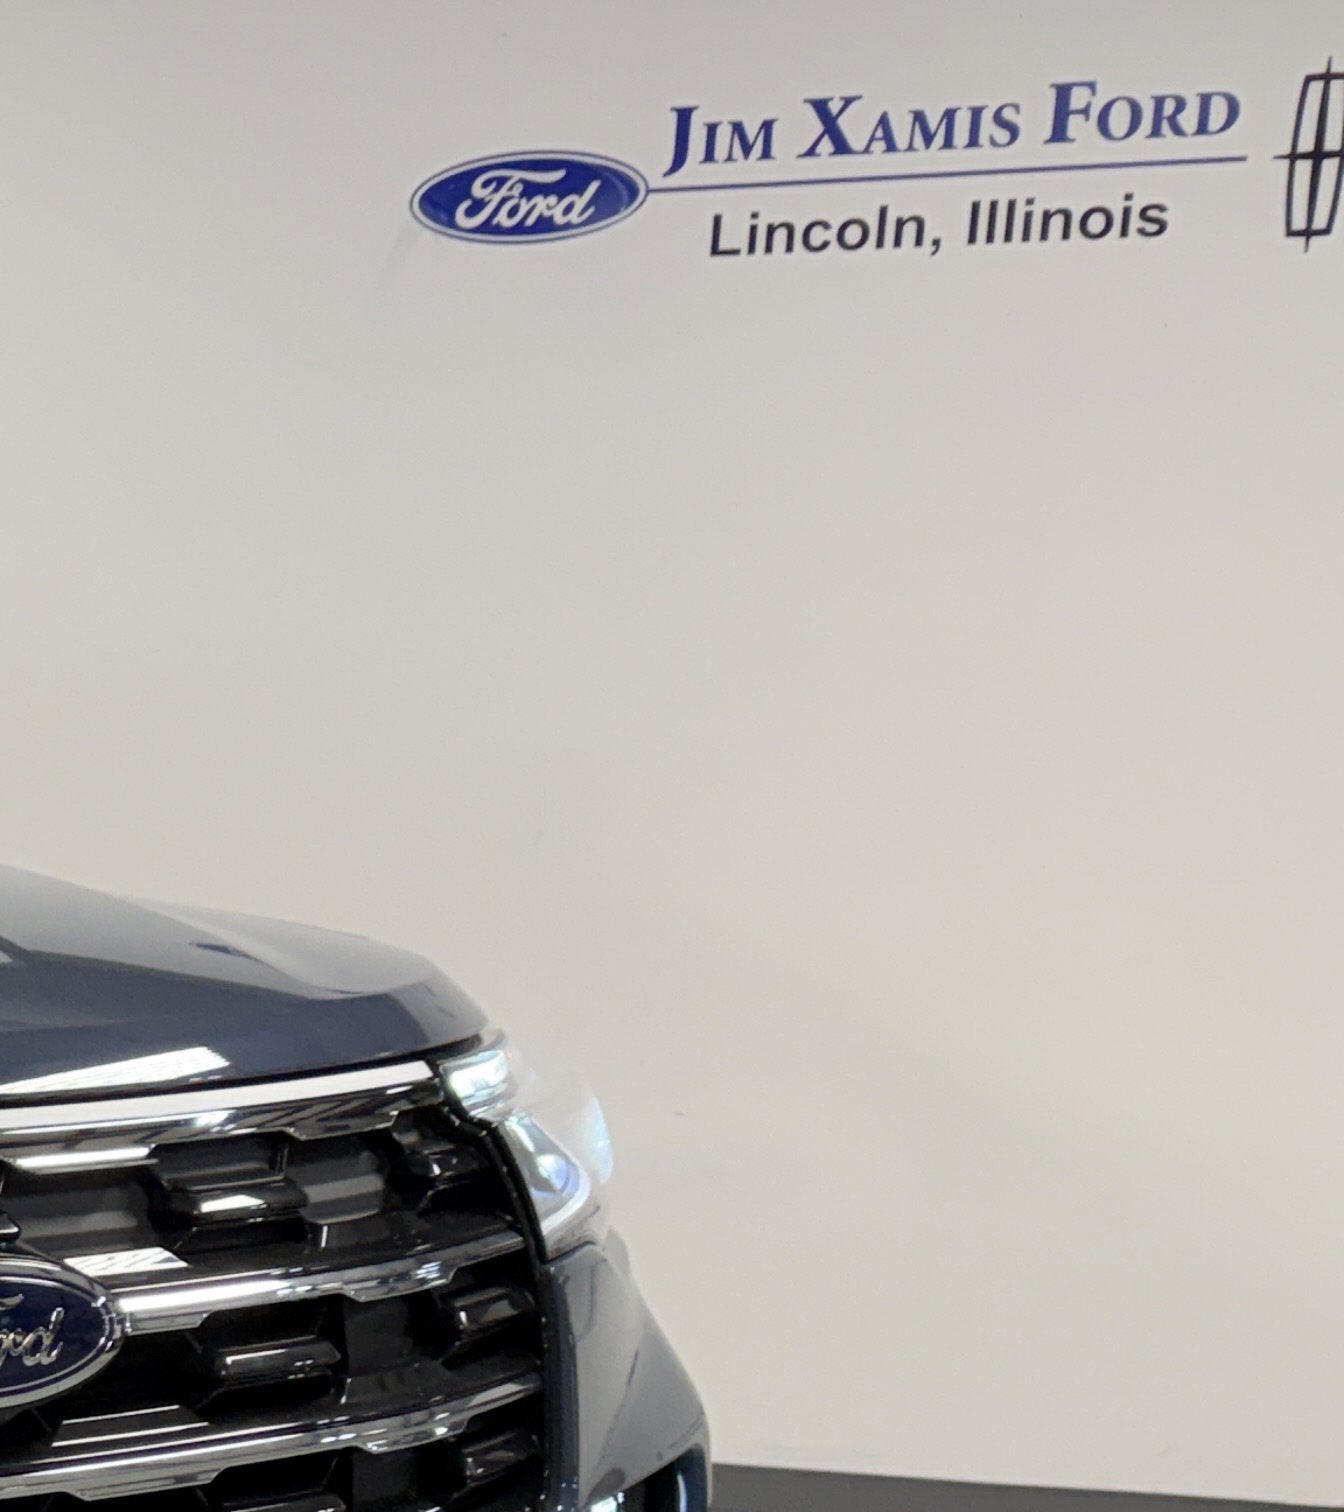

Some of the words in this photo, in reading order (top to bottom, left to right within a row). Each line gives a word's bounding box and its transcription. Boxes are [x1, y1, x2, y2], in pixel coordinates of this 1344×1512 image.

[663, 106, 778, 177] JIM
[798, 96, 1021, 158] XAMIS
[1044, 81, 1241, 146] FORD
[453, 169, 596, 228] Ford
[710, 204, 941, 257] Lincoln,
[965, 193, 1170, 246] Illinois
